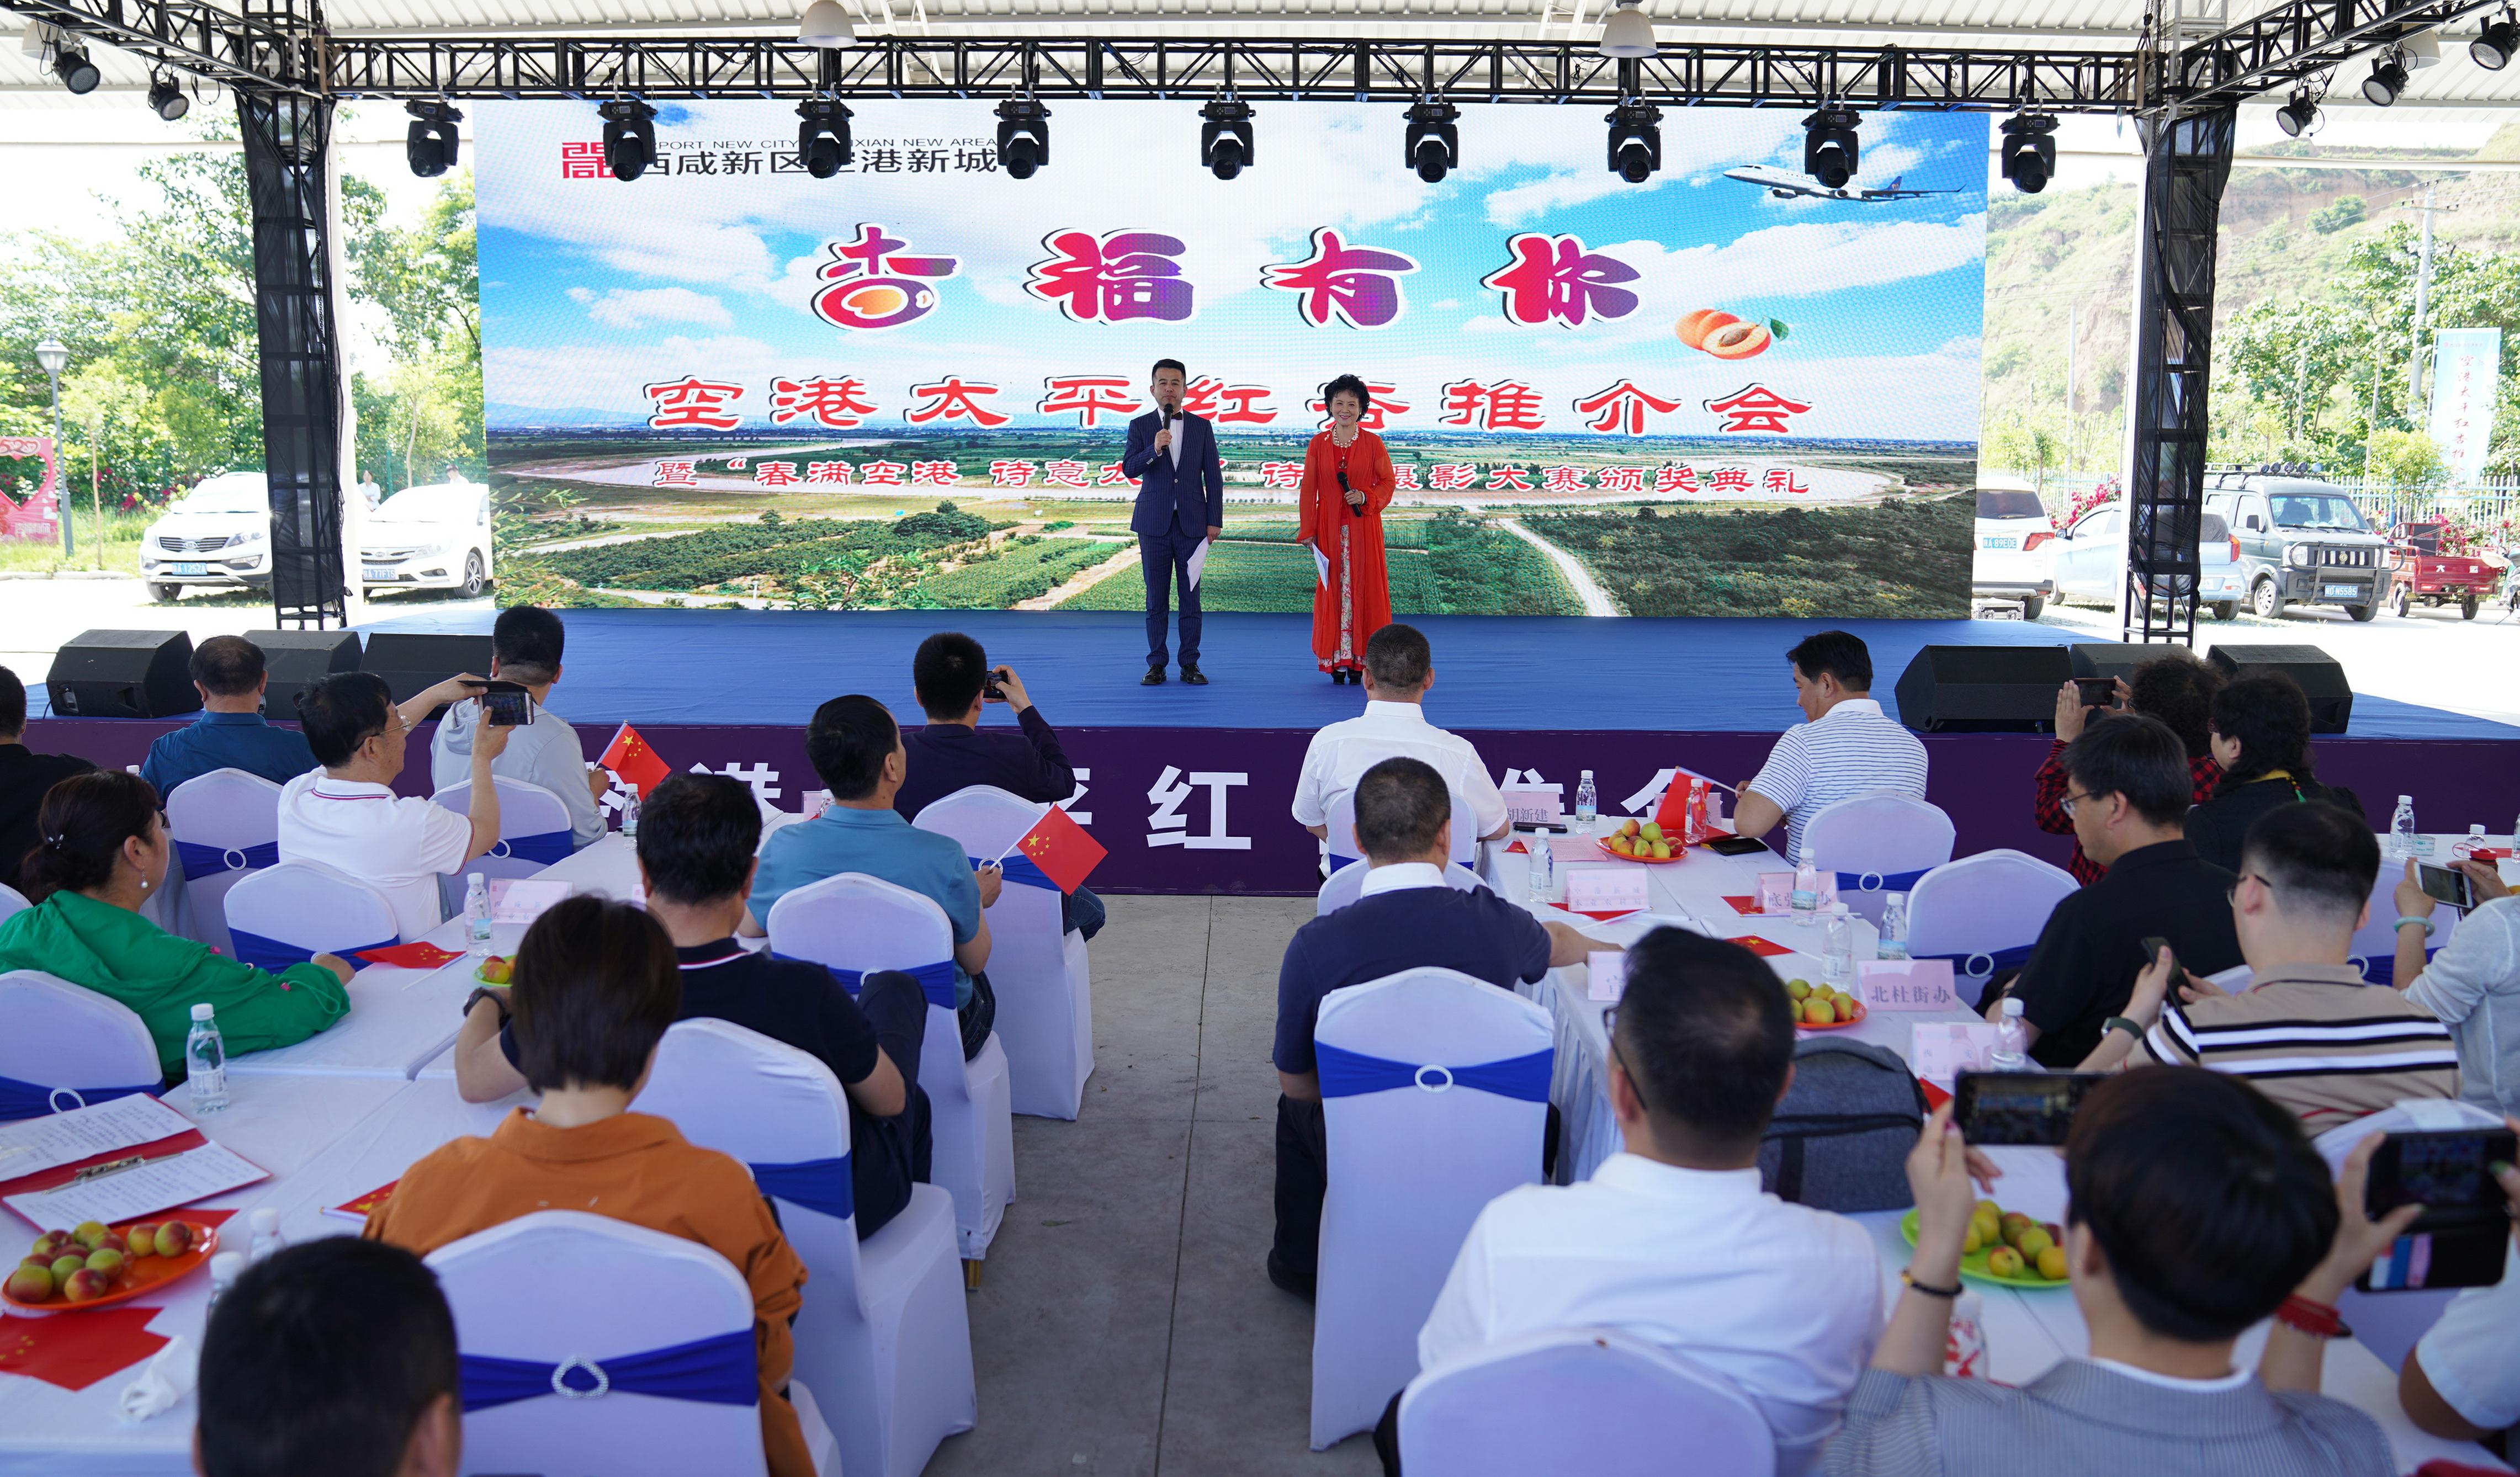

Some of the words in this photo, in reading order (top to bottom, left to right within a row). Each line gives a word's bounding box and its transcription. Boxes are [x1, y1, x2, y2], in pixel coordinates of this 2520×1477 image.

[658, 141, 705, 150] PORT
[713, 140, 753, 148] NEW
[760, 140, 799, 148] CITY
[851, 139, 894, 147] IXIAN
[903, 138, 943, 147] NEW
[950, 137, 998, 147] AREA
[1871, 985, 1951, 1004] 北杜街办
